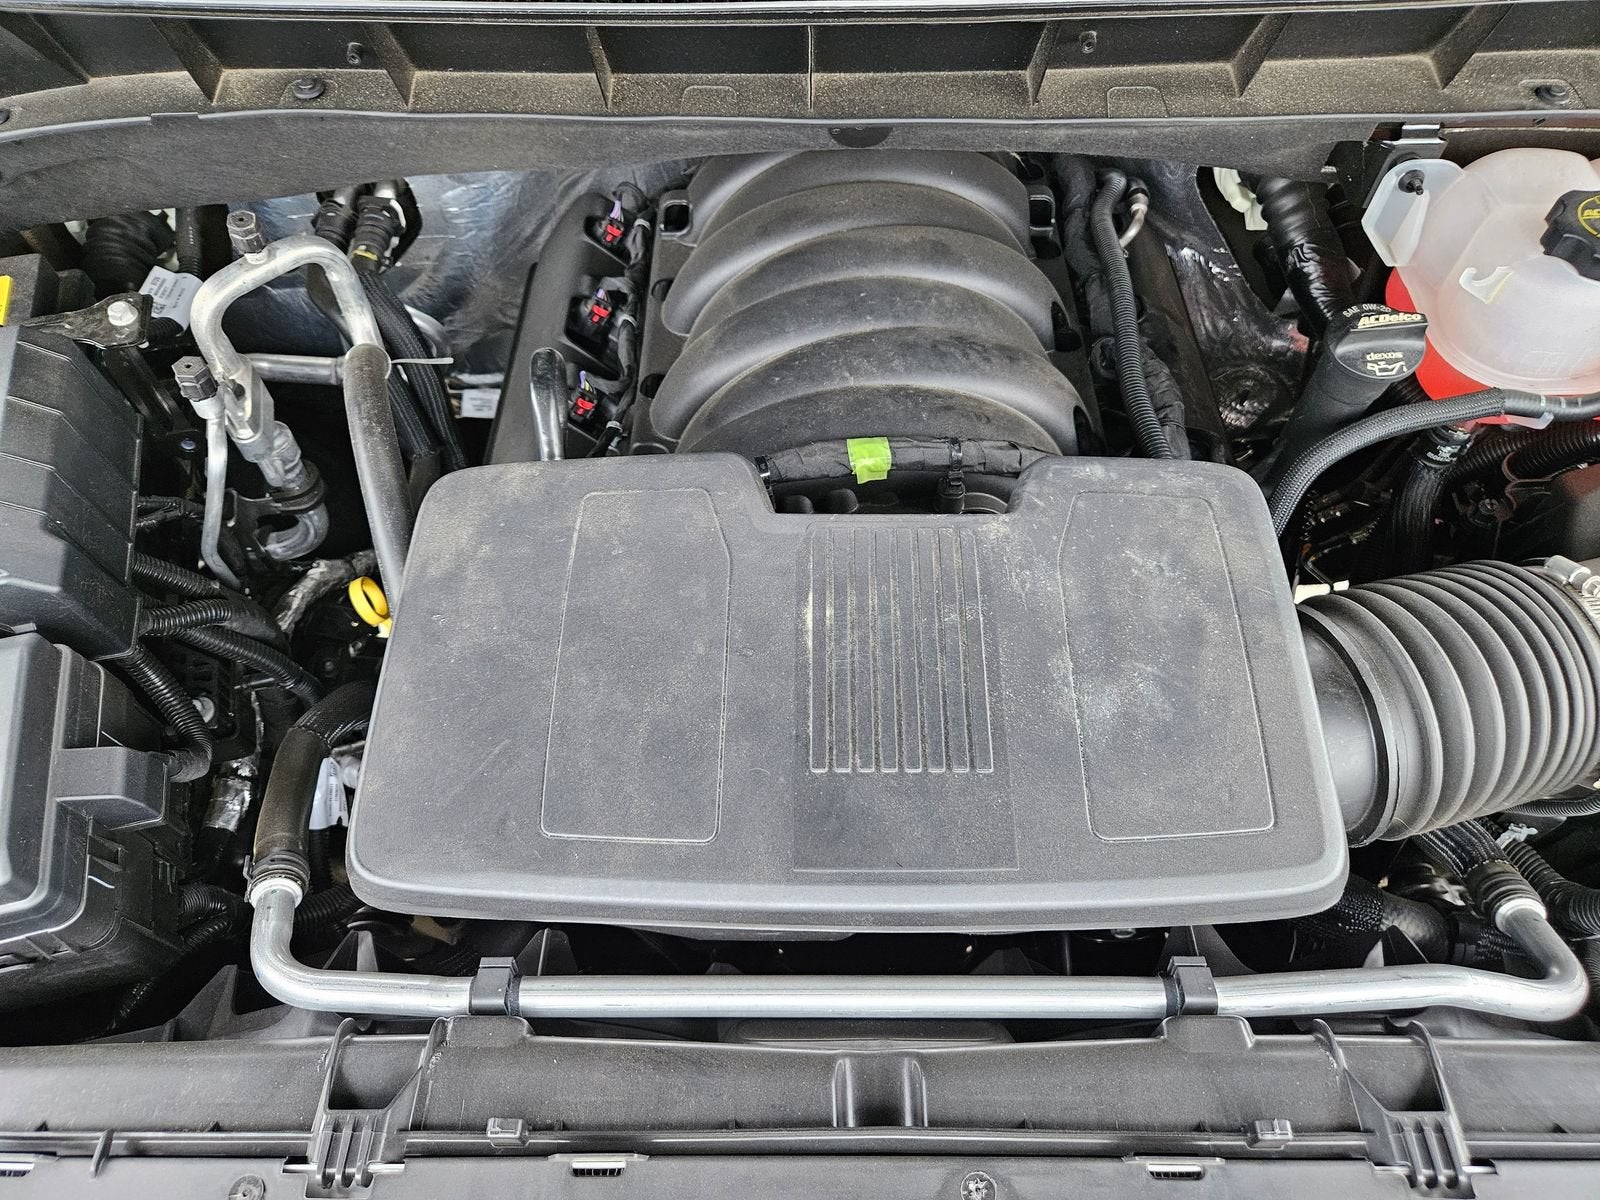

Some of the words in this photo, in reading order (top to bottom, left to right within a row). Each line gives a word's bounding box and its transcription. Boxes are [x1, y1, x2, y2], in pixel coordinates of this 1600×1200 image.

[1342, 305, 1360, 318] SAE
[1358, 312, 1422, 327] ACDelco
[1366, 351, 1403, 361] dexos
